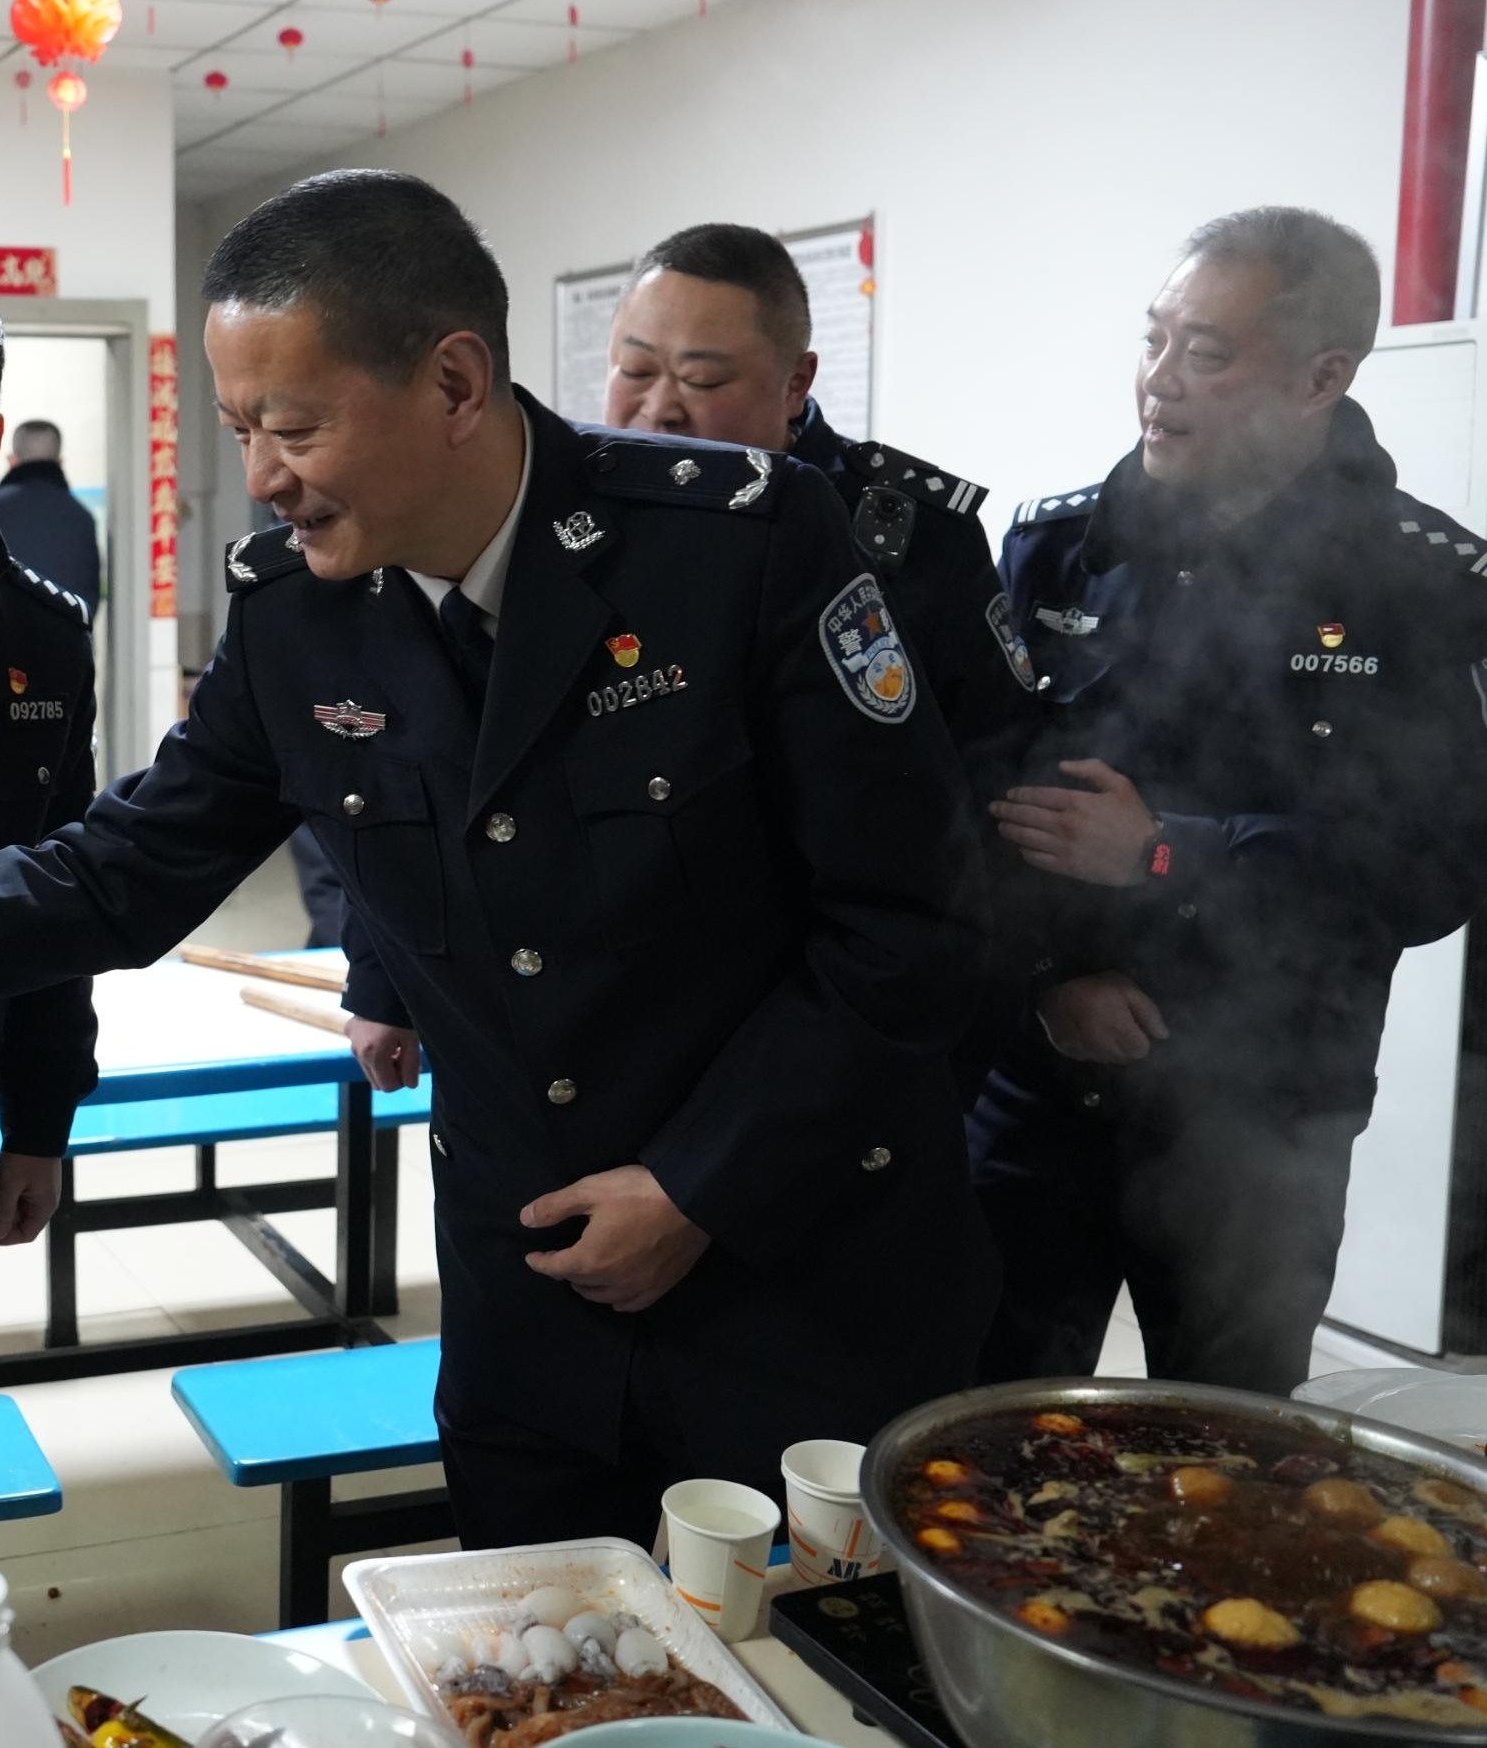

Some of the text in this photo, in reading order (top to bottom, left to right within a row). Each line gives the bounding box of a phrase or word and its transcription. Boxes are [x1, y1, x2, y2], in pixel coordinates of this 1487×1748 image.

[1290, 653, 1379, 675] 007566
[587, 664, 689, 717] 002842
[10, 701, 64, 720] 092785
